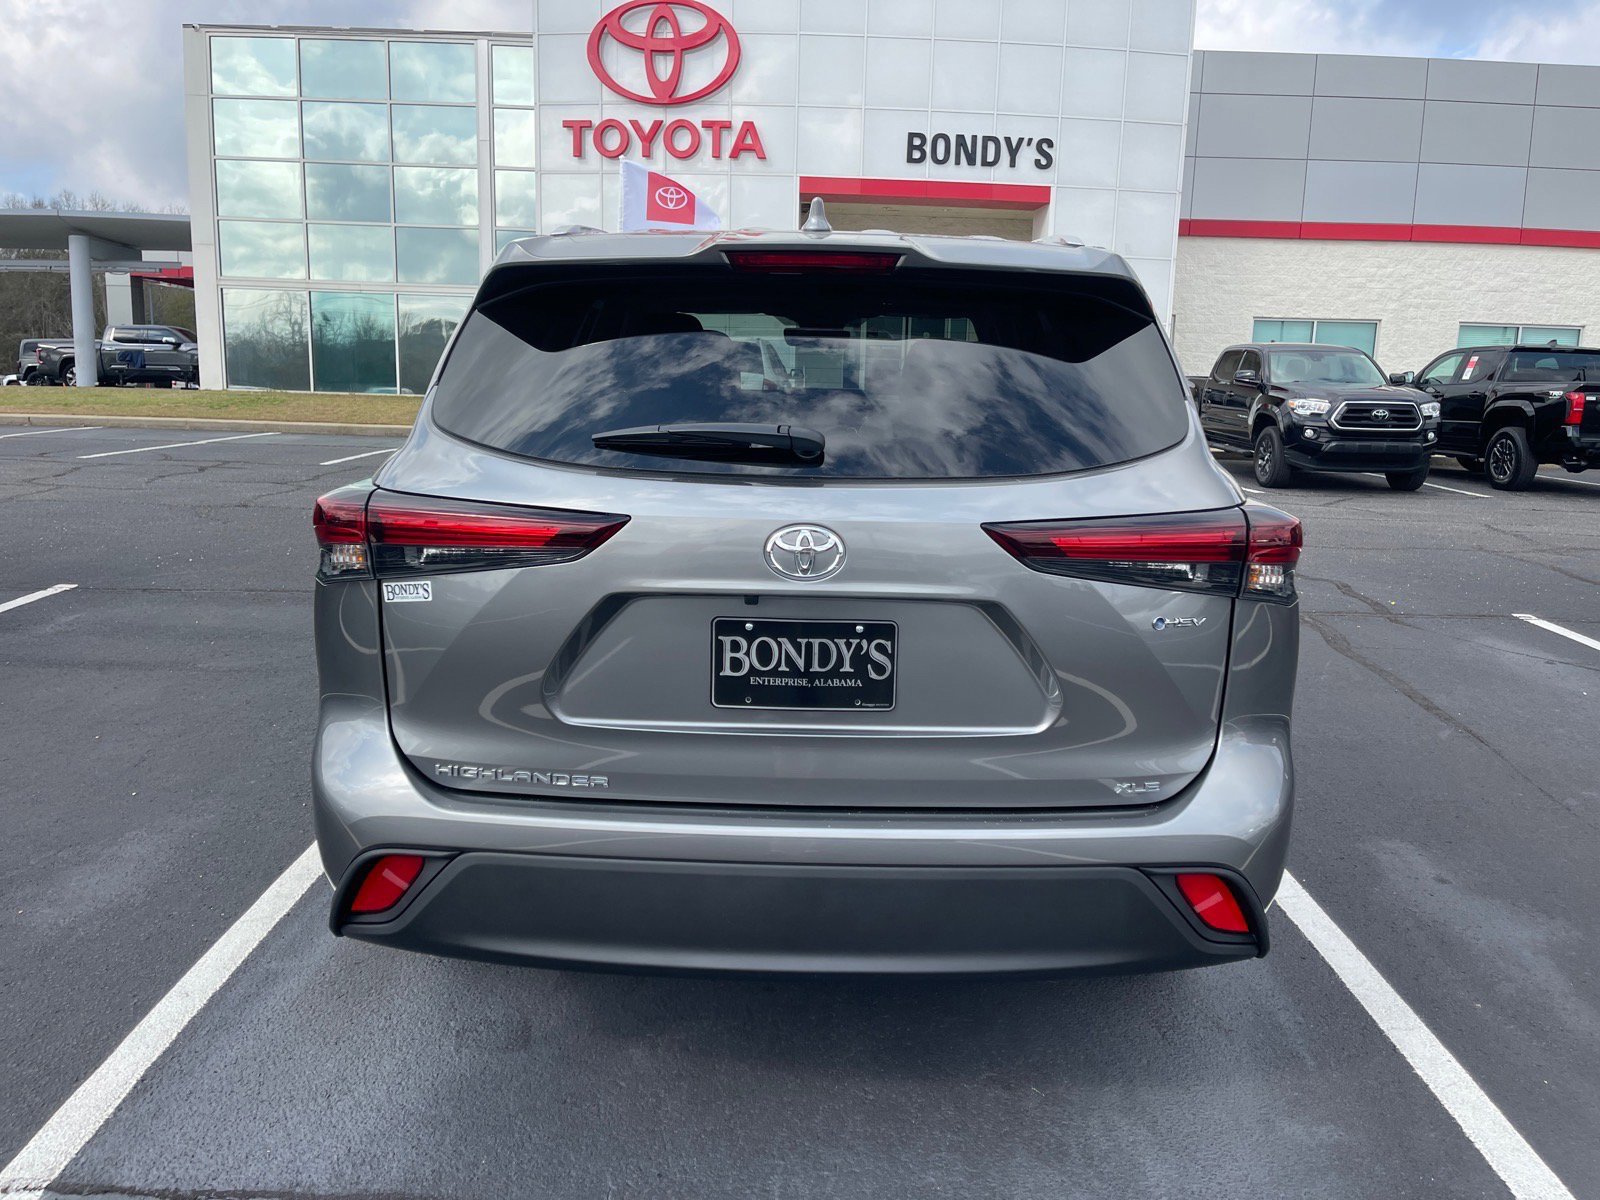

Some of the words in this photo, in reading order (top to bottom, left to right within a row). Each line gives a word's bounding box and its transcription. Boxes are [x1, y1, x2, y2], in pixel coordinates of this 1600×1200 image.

[562, 118, 767, 160] TOYOTA
[906, 131, 1054, 170] BONDY'S
[384, 583, 430, 601] BONDY'S
[718, 635, 892, 680] BONDY'S
[750, 676, 811, 687] ENTERPRISE,
[813, 679, 862, 687] ALABAMA
[434, 763, 610, 788] HIGHLANDER
[1113, 781, 1161, 794] XLE
